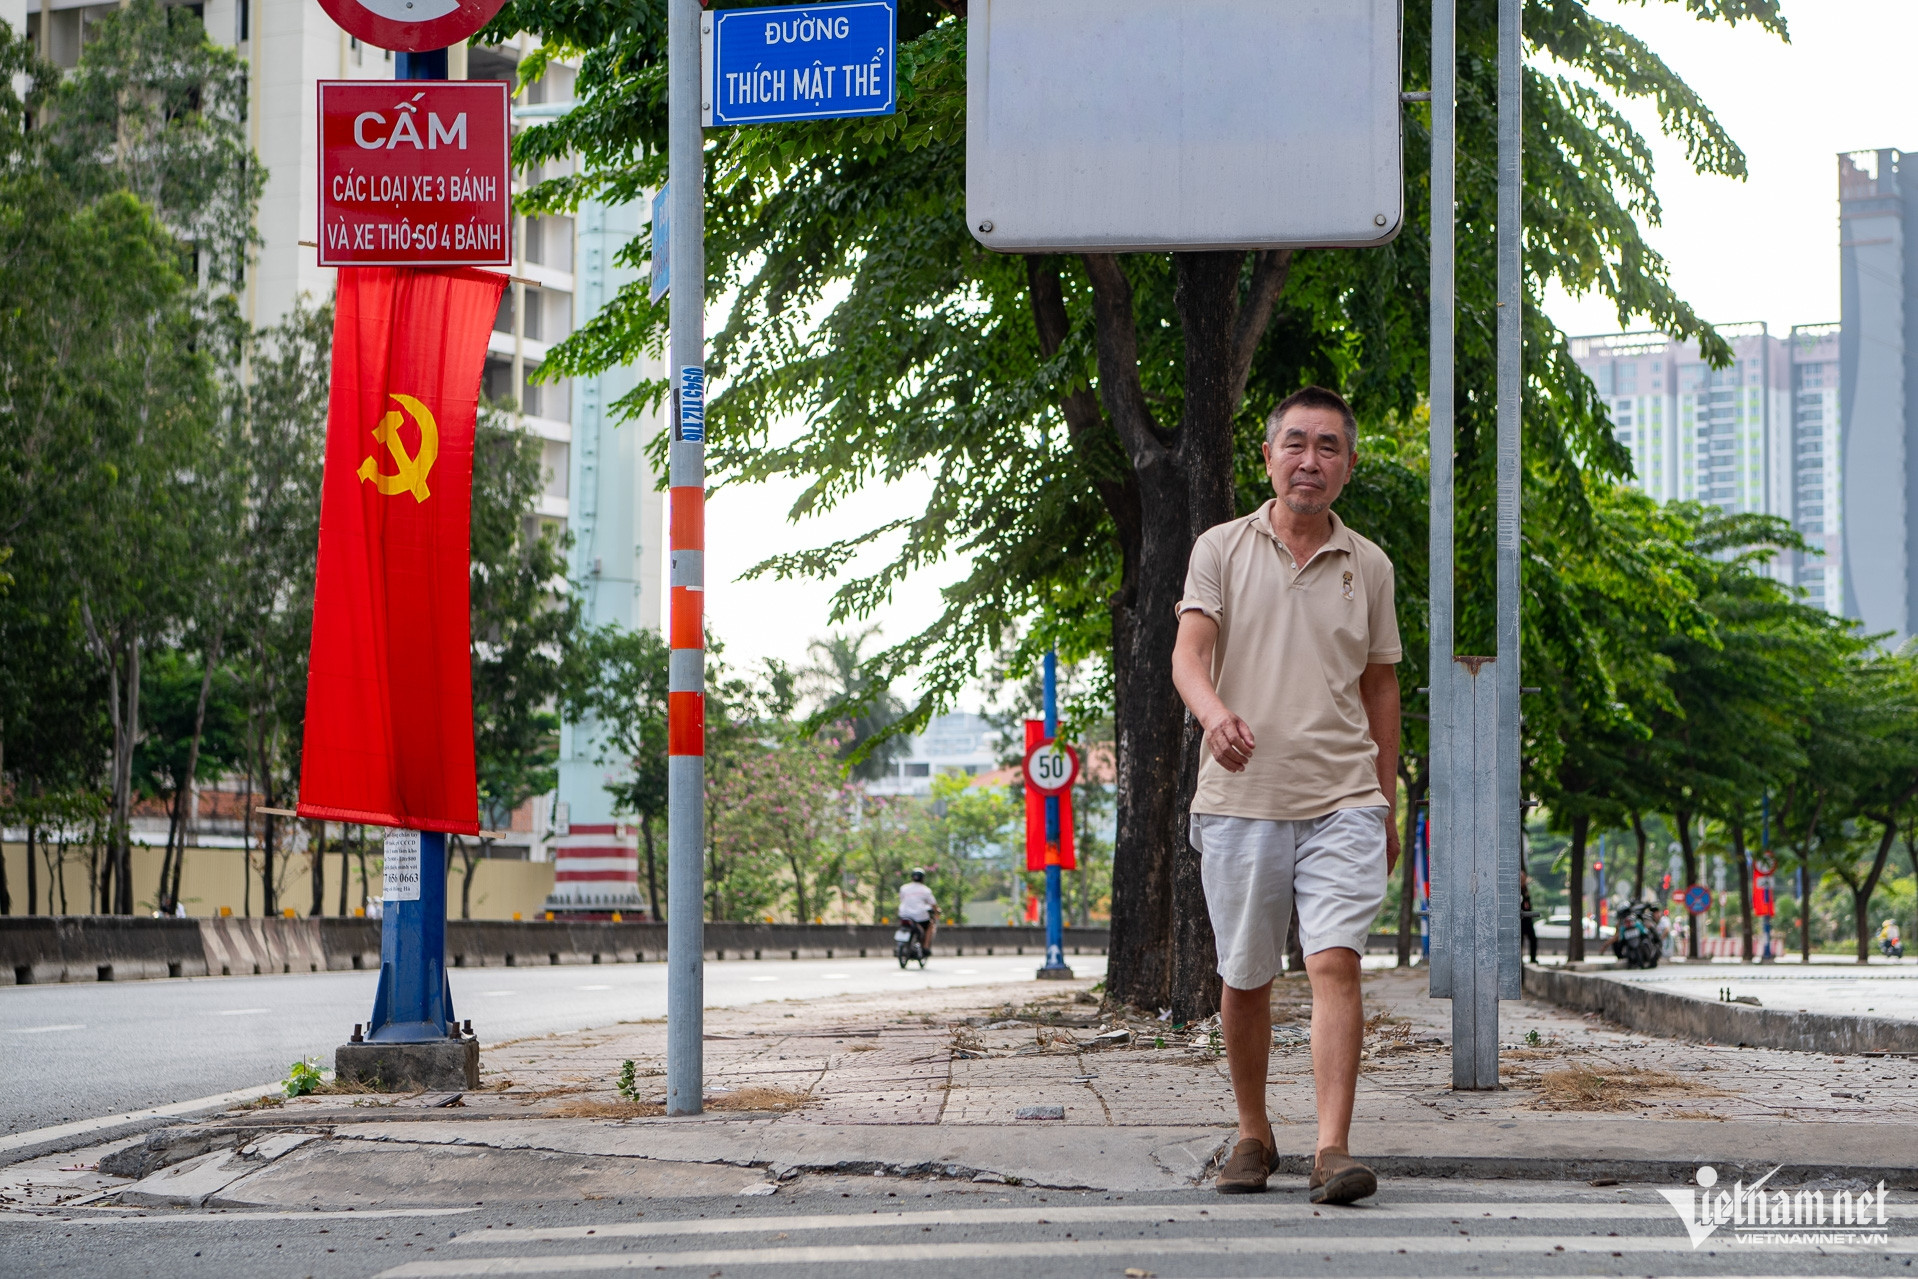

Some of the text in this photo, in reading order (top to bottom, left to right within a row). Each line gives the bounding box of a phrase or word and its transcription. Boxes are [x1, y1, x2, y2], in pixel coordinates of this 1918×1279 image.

[765, 12, 849, 45] ĐƯỜNG
[726, 47, 885, 106] THÍCH MẬT THỂ
[354, 92, 467, 150] CẤM
[333, 167, 496, 208] CÁC LOẠI XE 3 BÁNH
[327, 215, 500, 250] VÀ XE THÔ SƠ 4 BÁNH
[1039, 755, 1063, 779] 50
[399, 873, 419, 883] 0663
